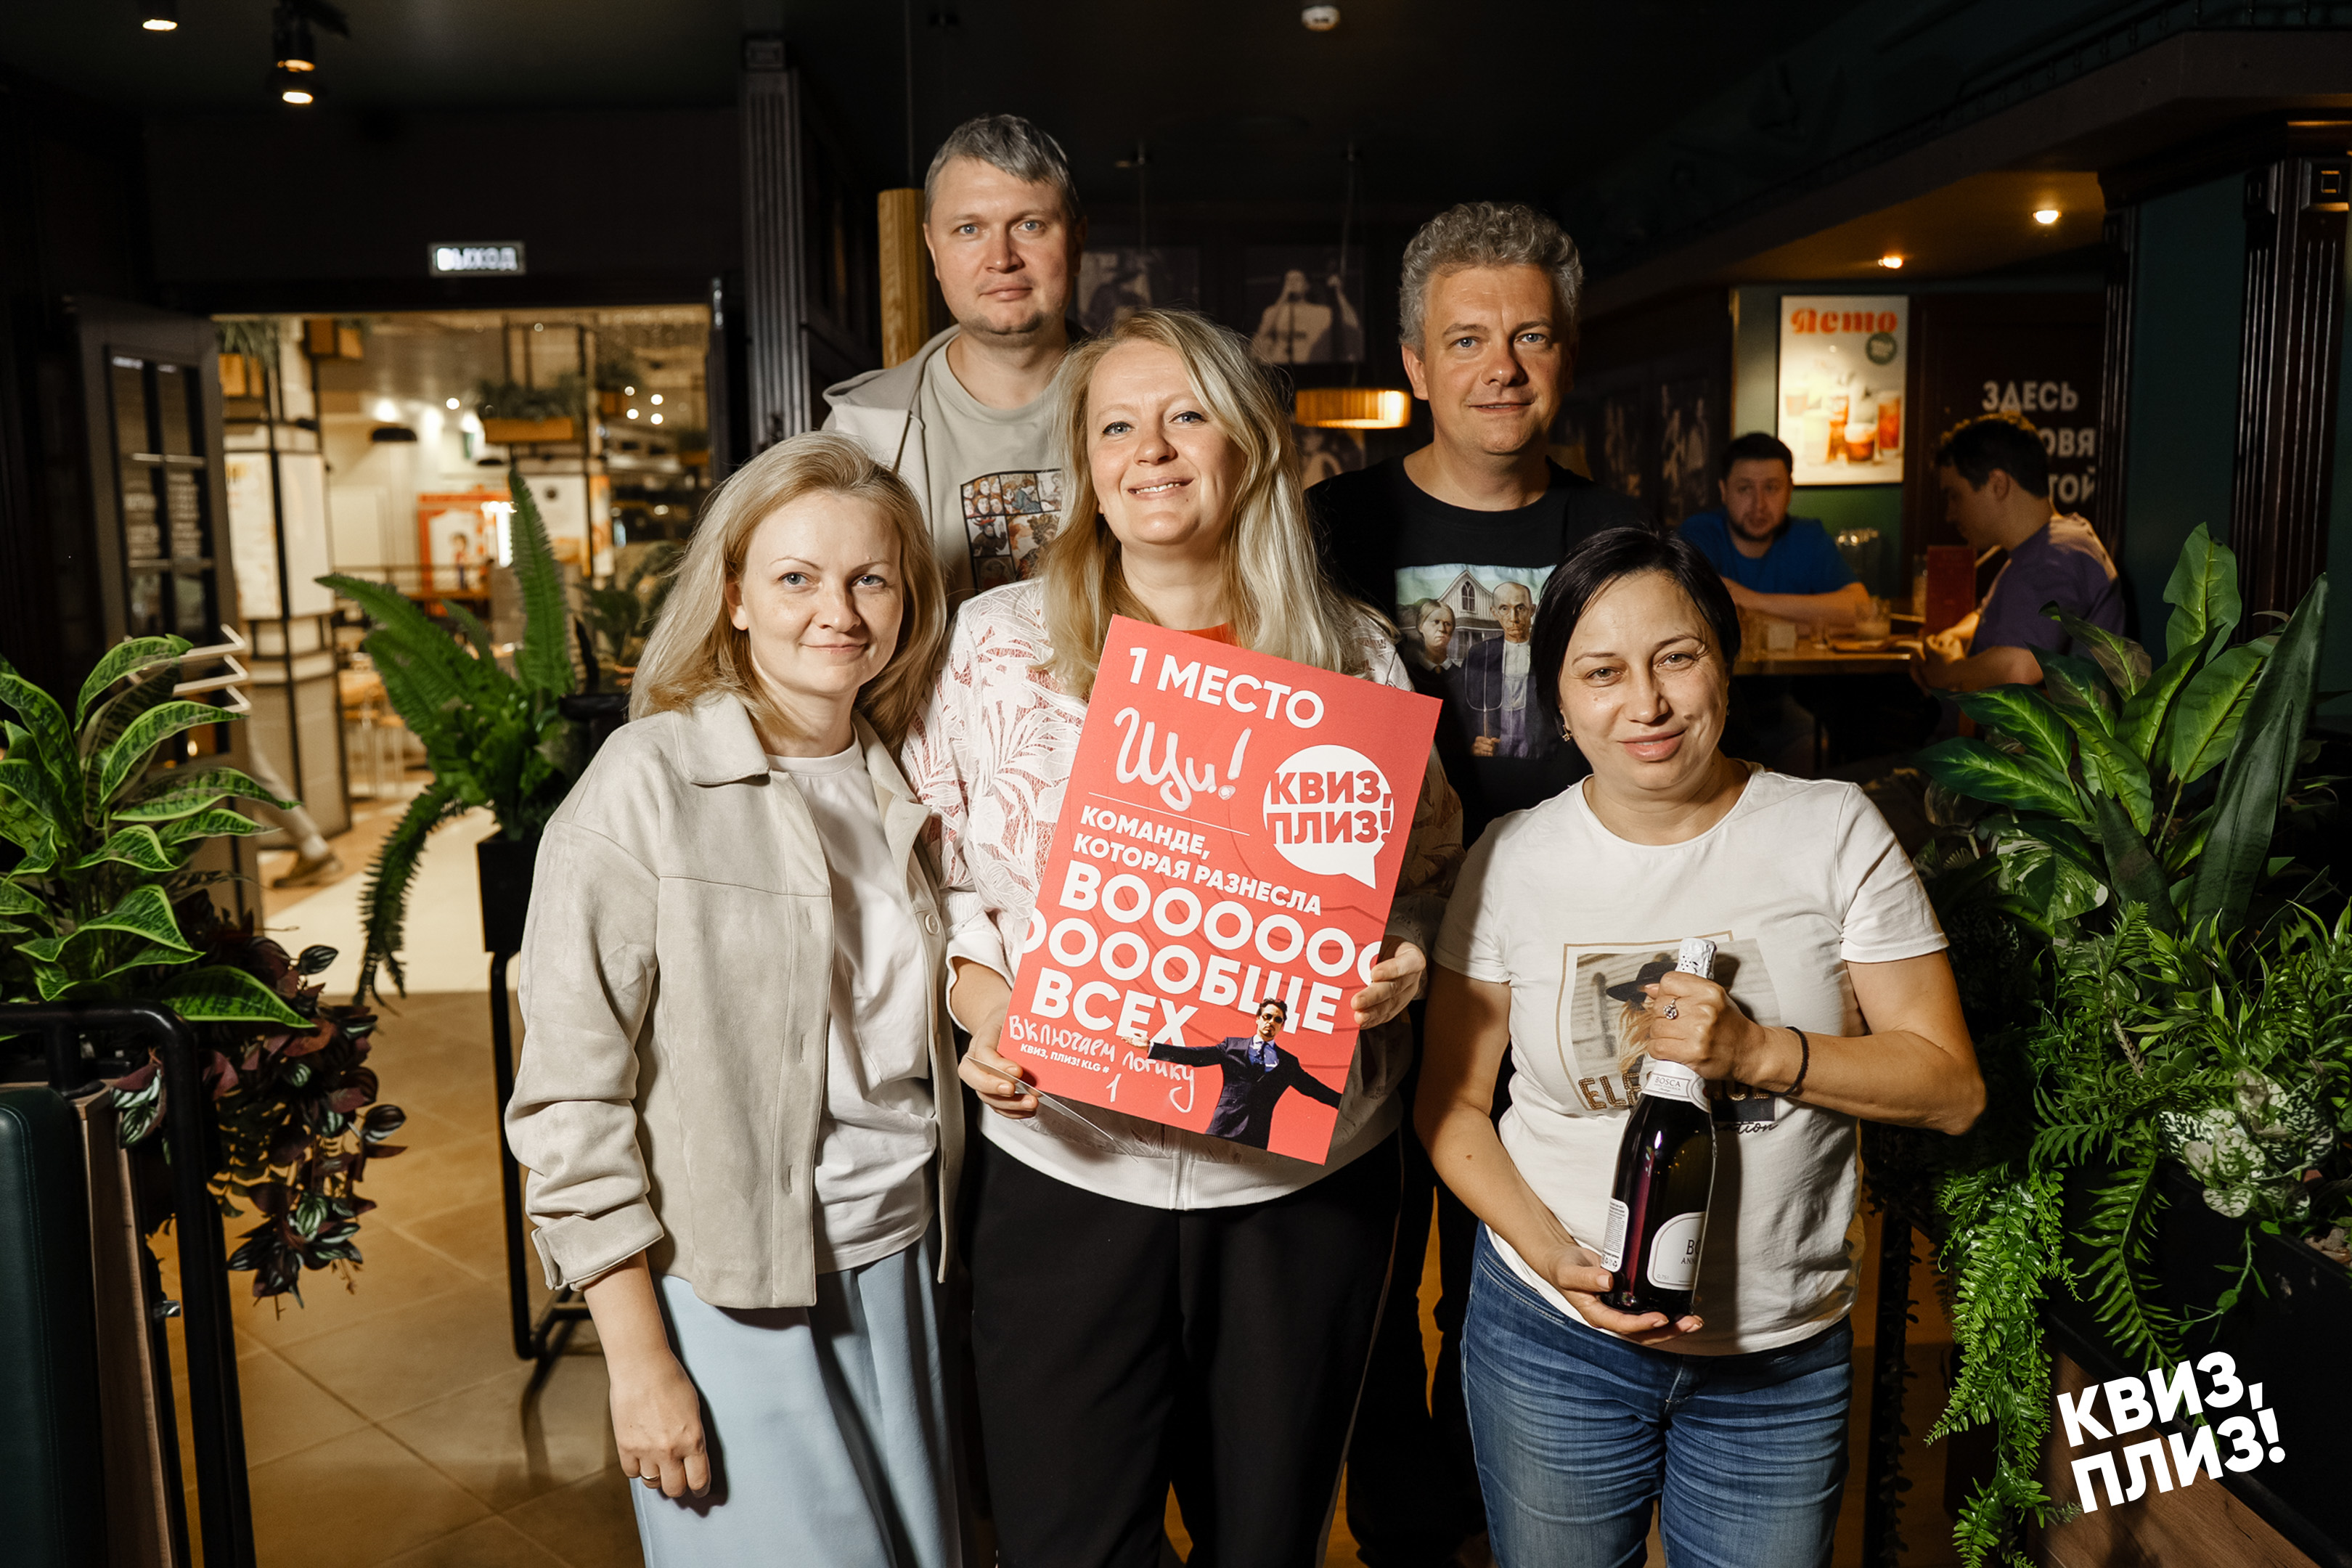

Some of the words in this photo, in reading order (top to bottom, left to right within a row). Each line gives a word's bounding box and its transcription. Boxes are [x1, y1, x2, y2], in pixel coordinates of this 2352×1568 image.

[1982, 380, 2078, 415] ЗДЕСЬ
[1130, 647, 1148, 685] 1
[1156, 654, 1325, 729] МЕСТО
[1269, 769, 1393, 809] КВИЗ,
[1079, 805, 1210, 859] КОМАНДЕ,
[1266, 810, 1392, 846] ПЛИЗ!
[1072, 835, 1191, 881] КОТОРАЯ
[1193, 865, 1322, 916] РАЗНЕСЛА
[1029, 966, 1199, 1048] ВСЕХ
[1020, 1043, 1049, 1060] КВИЗ,
[1050, 1051, 1080, 1066] ПЛИЗ!
[1080, 1058, 1101, 1073] KLG
[1654, 1076, 1681, 1087] BOSCA
